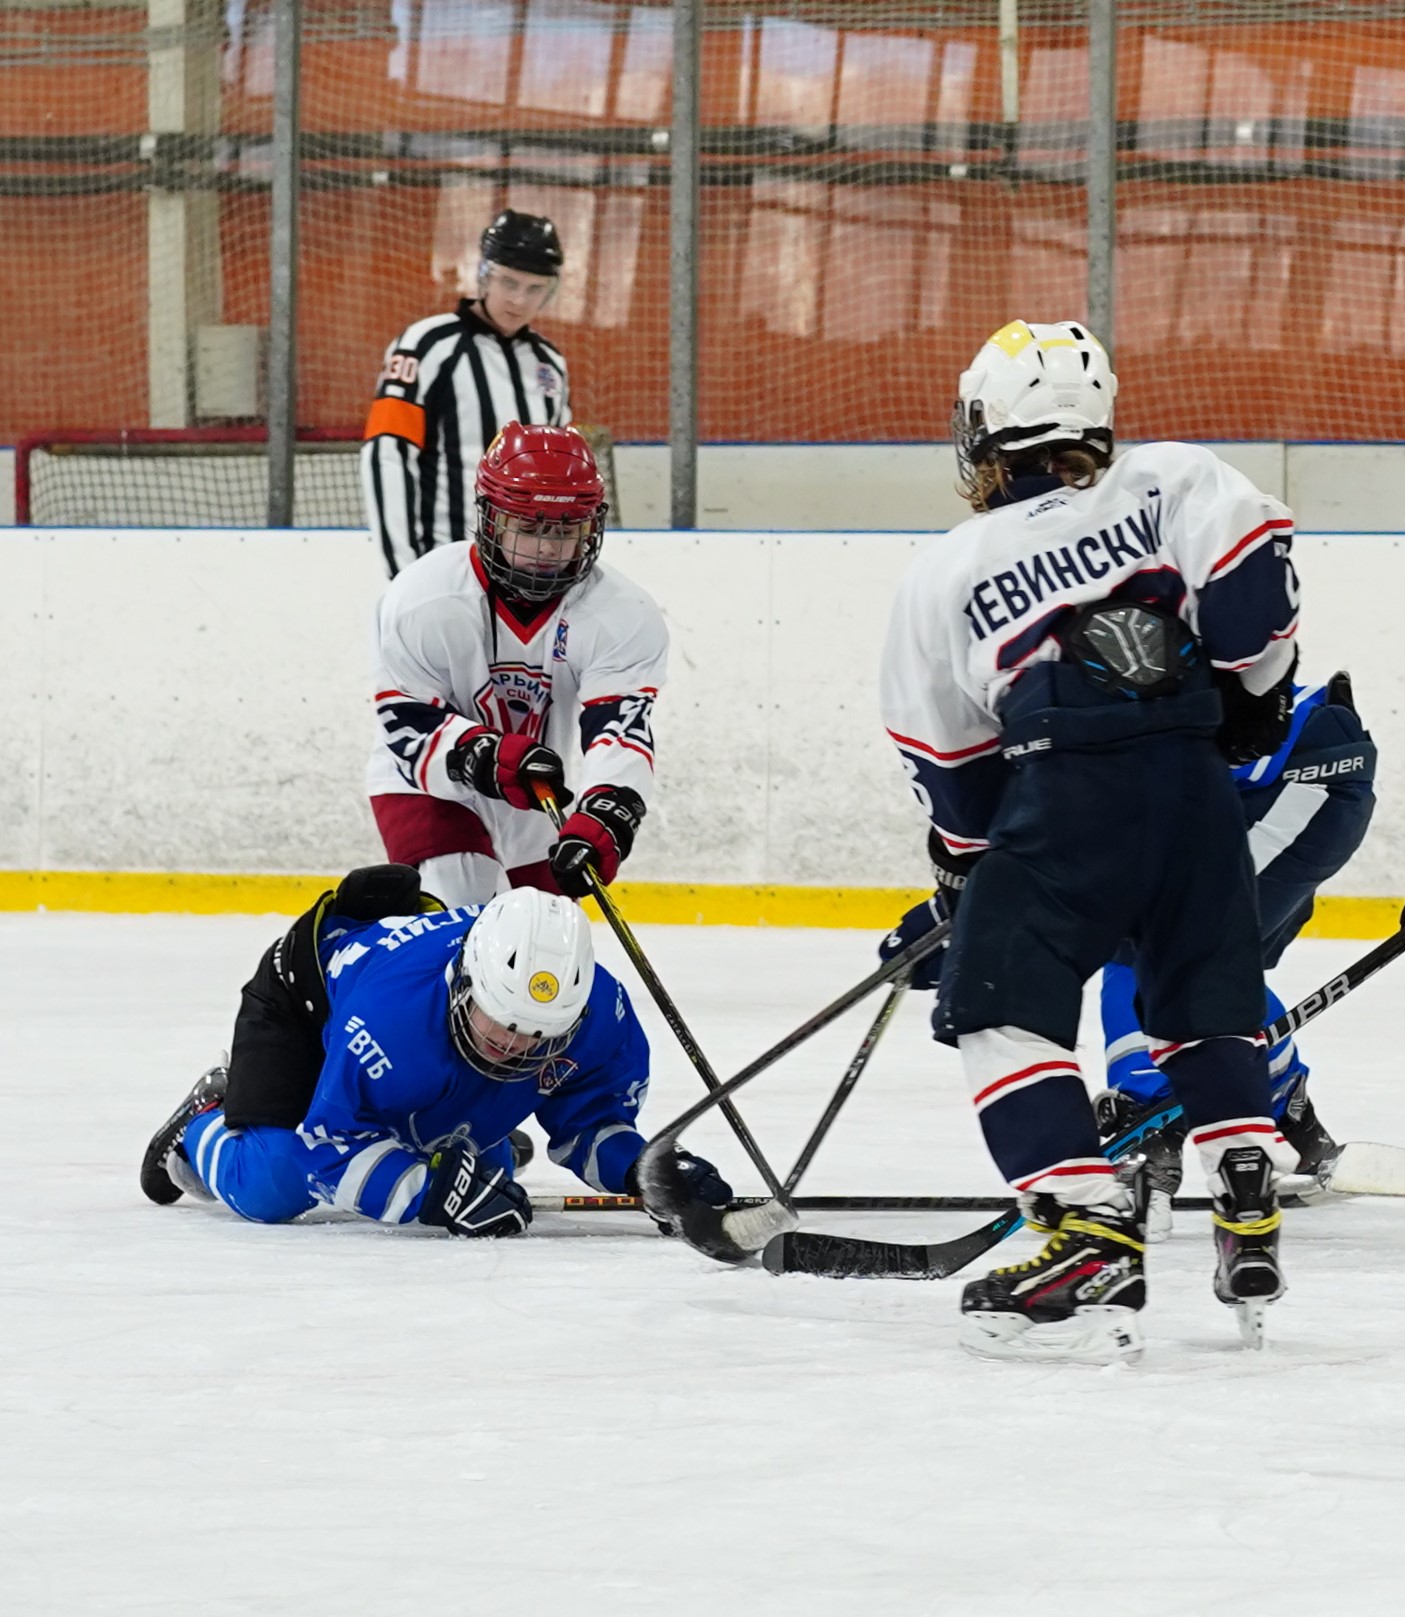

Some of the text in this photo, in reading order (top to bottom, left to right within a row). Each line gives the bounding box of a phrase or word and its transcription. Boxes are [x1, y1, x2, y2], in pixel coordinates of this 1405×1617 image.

[384, 354, 419, 384] 30
[507, 688, 531, 702] СШ
[347, 1029, 393, 1080] ВТБ
